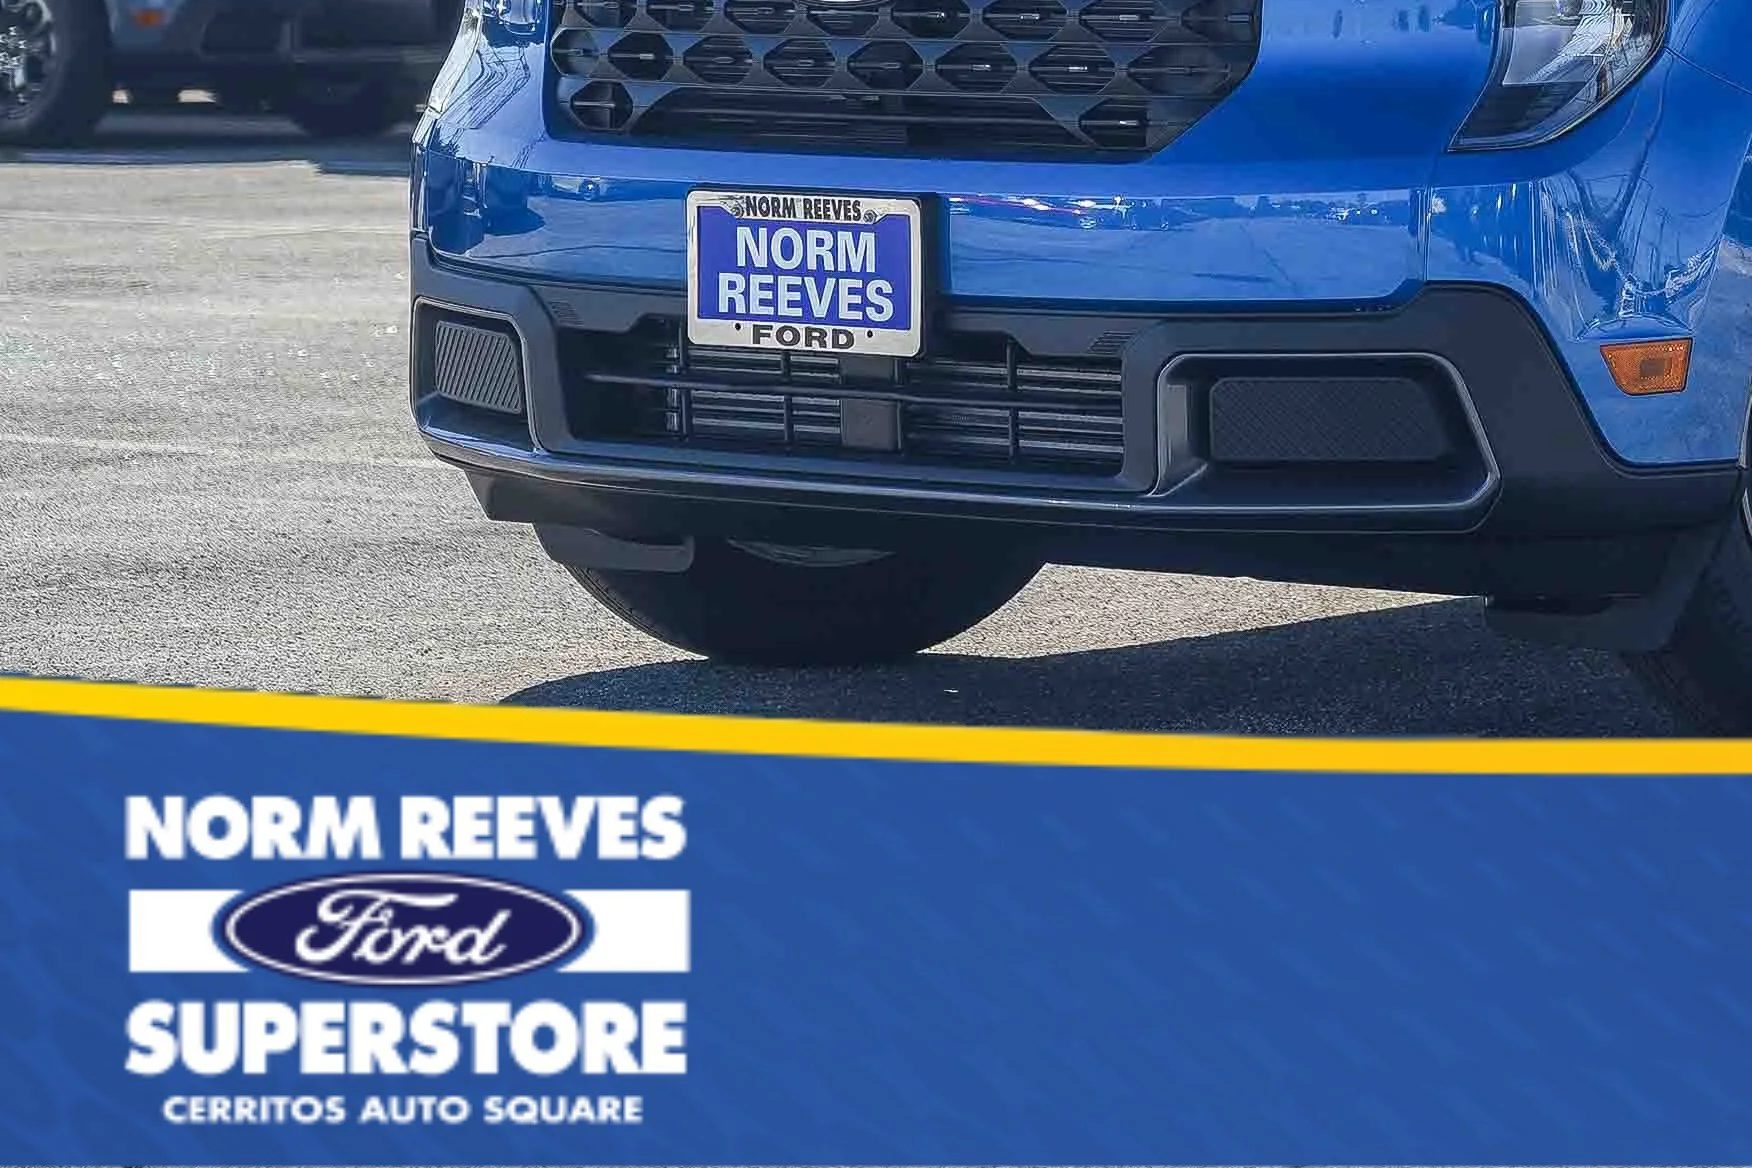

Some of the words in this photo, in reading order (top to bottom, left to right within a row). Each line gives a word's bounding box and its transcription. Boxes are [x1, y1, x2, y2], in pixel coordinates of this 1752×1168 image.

[746, 195, 798, 219] NORM
[804, 199, 862, 222] REEVES
[736, 226, 876, 273] NORM
[718, 272, 894, 322] REEVES
[752, 324, 855, 350] FORD
